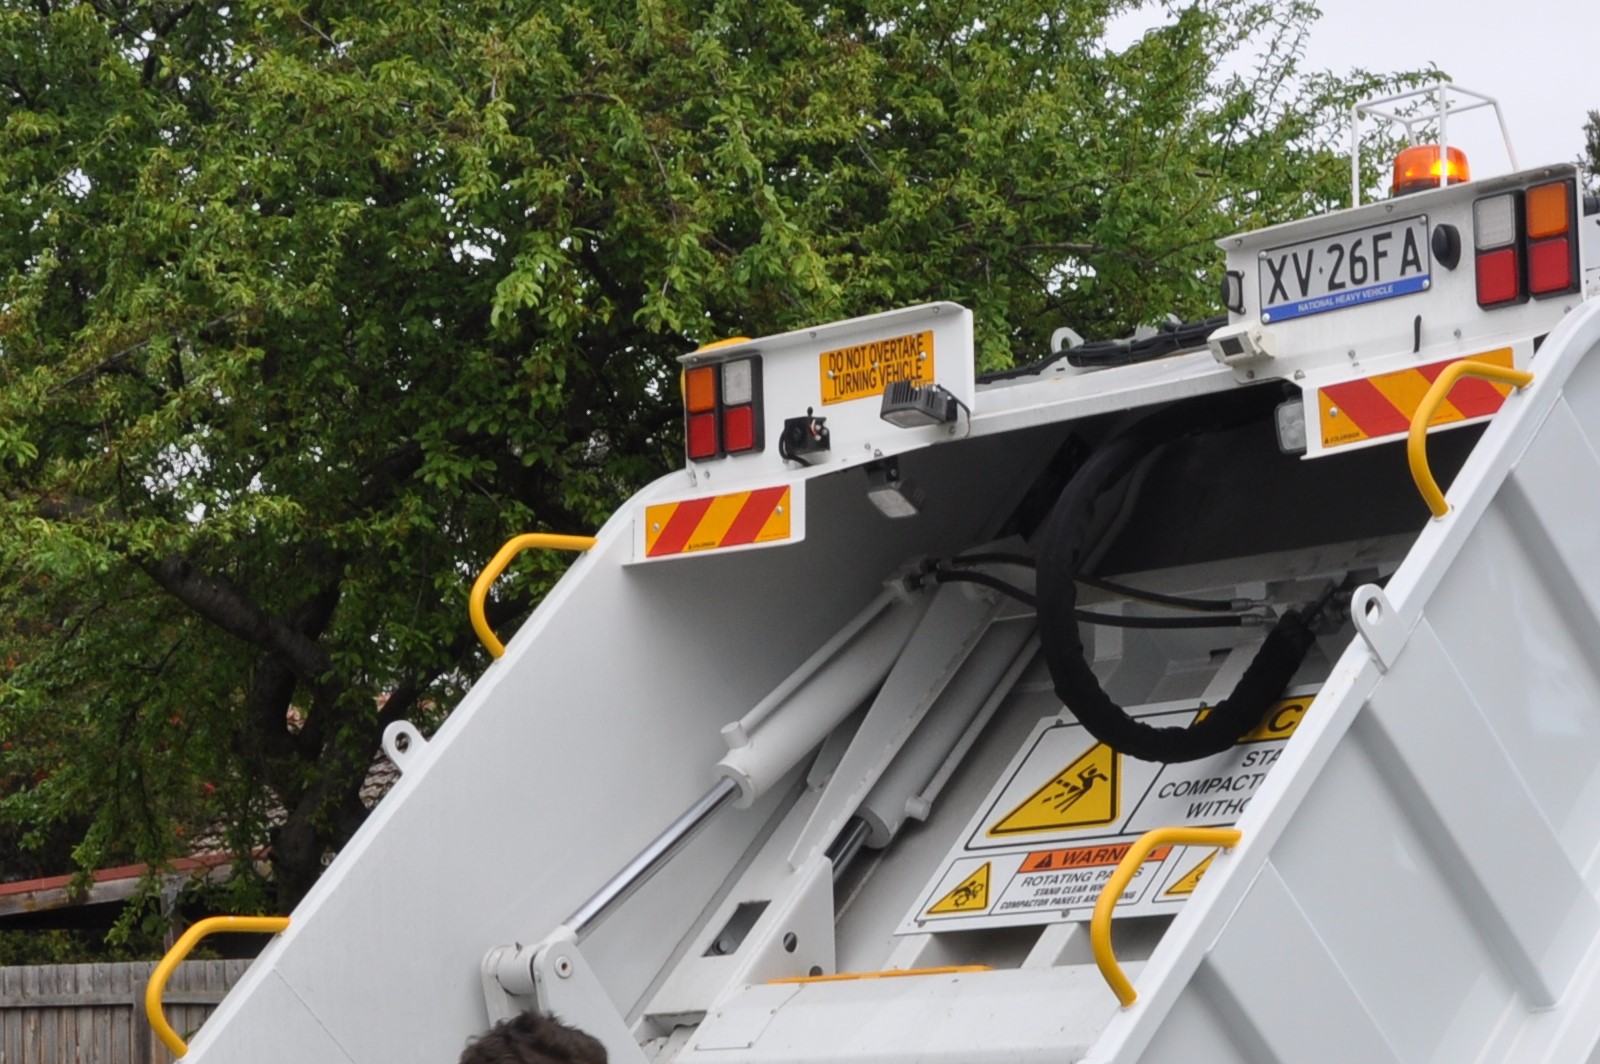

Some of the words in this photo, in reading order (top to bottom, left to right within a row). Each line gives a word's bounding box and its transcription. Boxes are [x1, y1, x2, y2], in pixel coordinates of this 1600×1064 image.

[1298, 299, 1335, 313] NATIONAL
[1336, 292, 1361, 307] HEAVY
[1362, 284, 1394, 301] VEHICLE
[829, 352, 843, 373] DO
[846, 346, 866, 370] NOT
[869, 334, 923, 366] OVERTAKE
[832, 367, 877, 397] TURNING
[878, 357, 922, 387] VEHICLE
[1242, 748, 1284, 768] STA
[1158, 773, 1266, 799] COMPACT
[1021, 871, 1093, 888] ROTATING
[1033, 887, 1061, 897] STAND
[1062, 884, 1087, 895] CLEAR
[1000, 899, 1048, 910] COMPACTOR
[1049, 895, 1081, 907] PANELS
